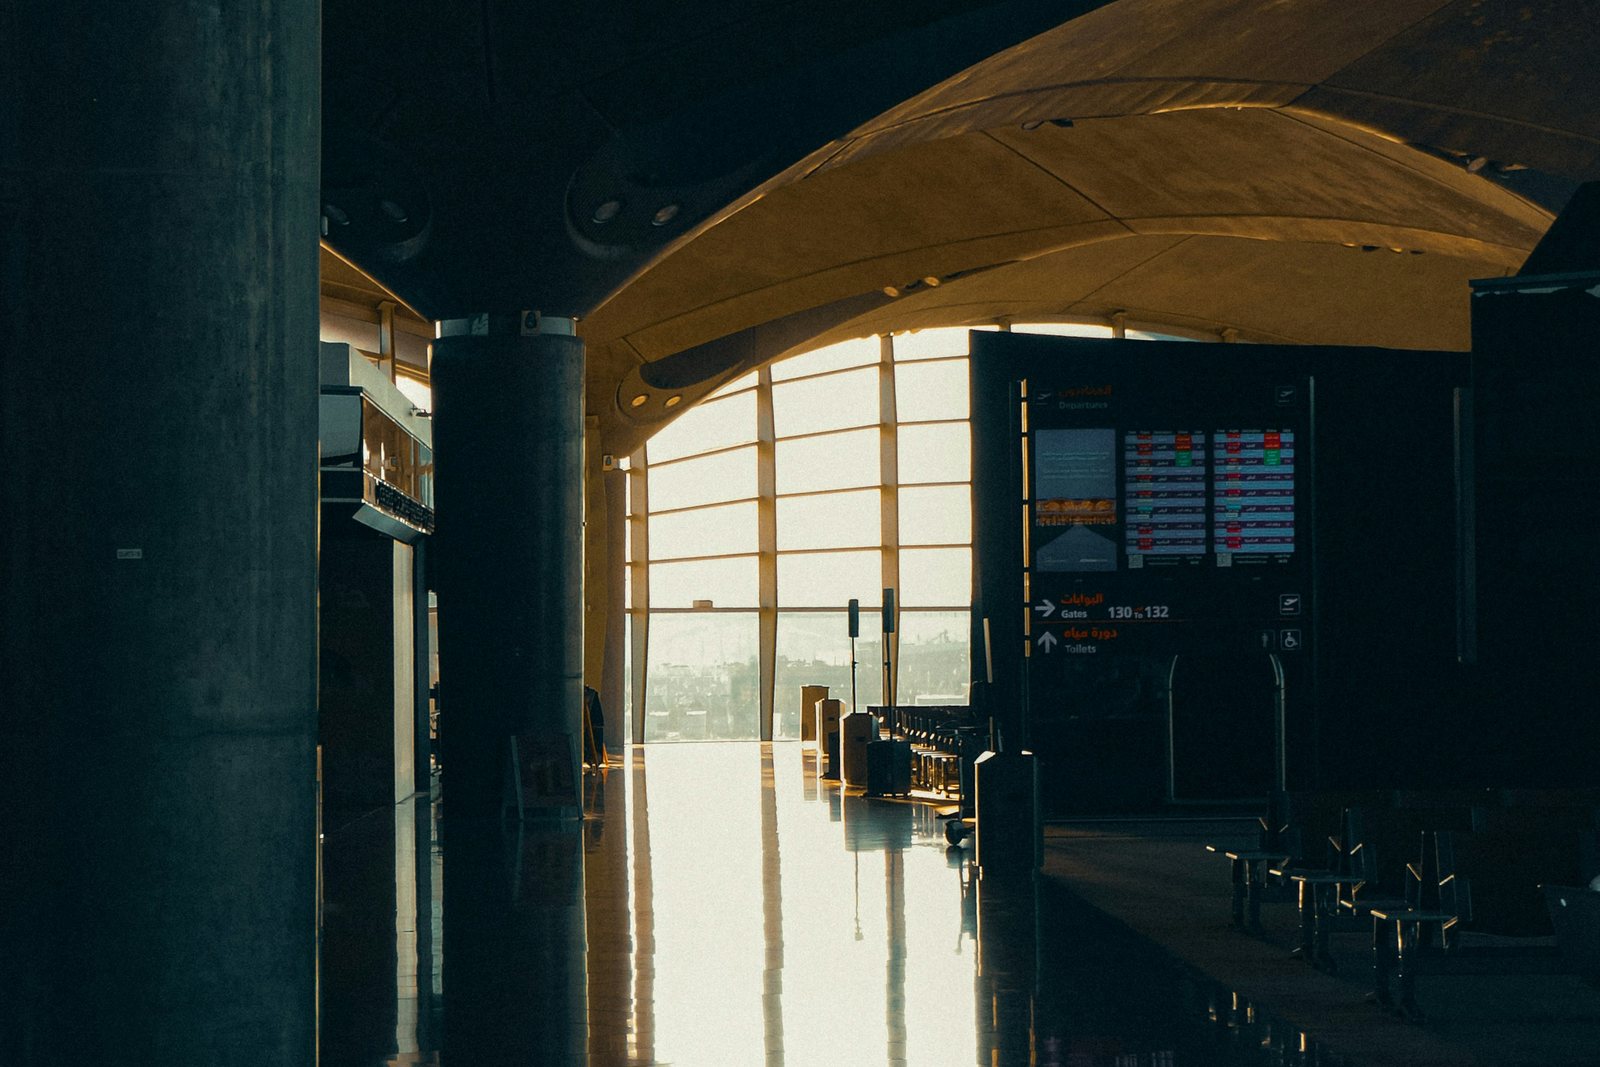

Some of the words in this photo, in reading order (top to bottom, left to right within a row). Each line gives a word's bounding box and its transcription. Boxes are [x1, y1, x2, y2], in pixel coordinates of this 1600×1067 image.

[1059, 400, 1108, 411] Departures
[1060, 592, 1104, 606] البوابات
[1061, 609, 1088, 619] Gates
[1108, 606, 1133, 619] 130
[1145, 605, 1169, 618] 132
[1091, 627, 1119, 641] دورة
[1064, 643, 1097, 654] Toilets
